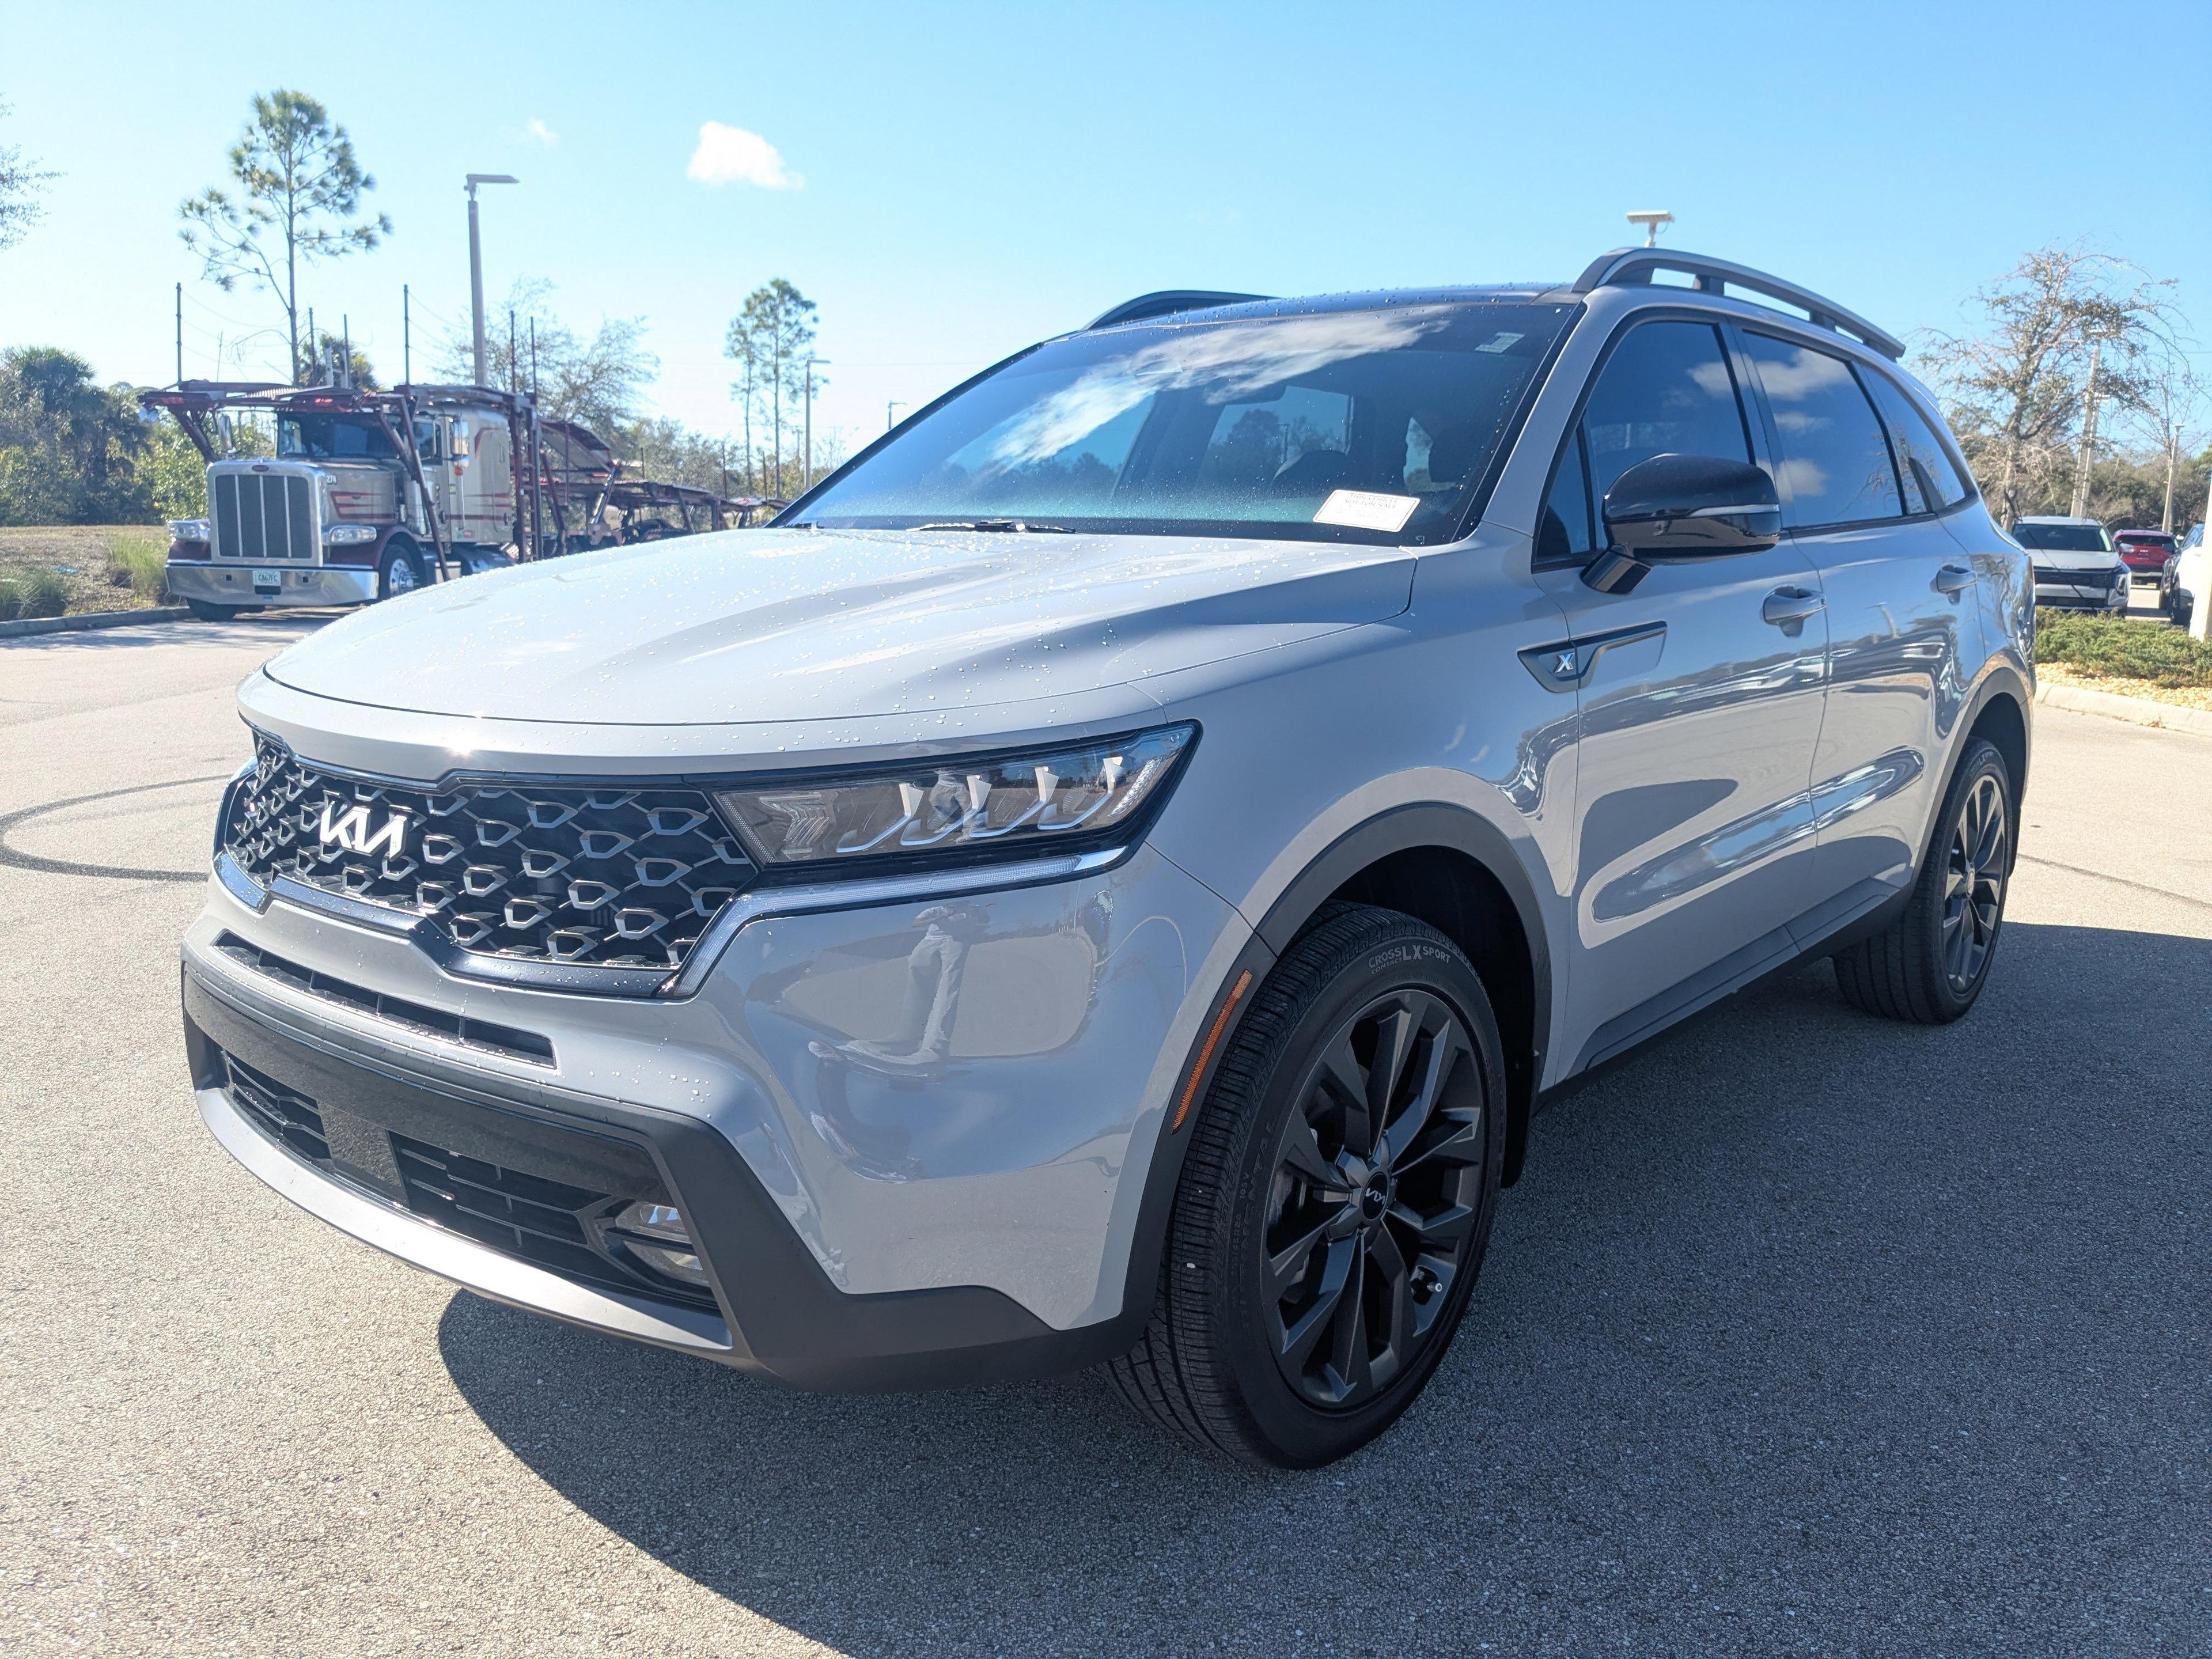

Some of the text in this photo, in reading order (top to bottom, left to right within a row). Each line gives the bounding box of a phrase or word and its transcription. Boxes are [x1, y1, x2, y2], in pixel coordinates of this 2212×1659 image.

[1368, 944, 1451, 969] CROSS LX SPORT
[1370, 957, 1403, 975] CONTACT
